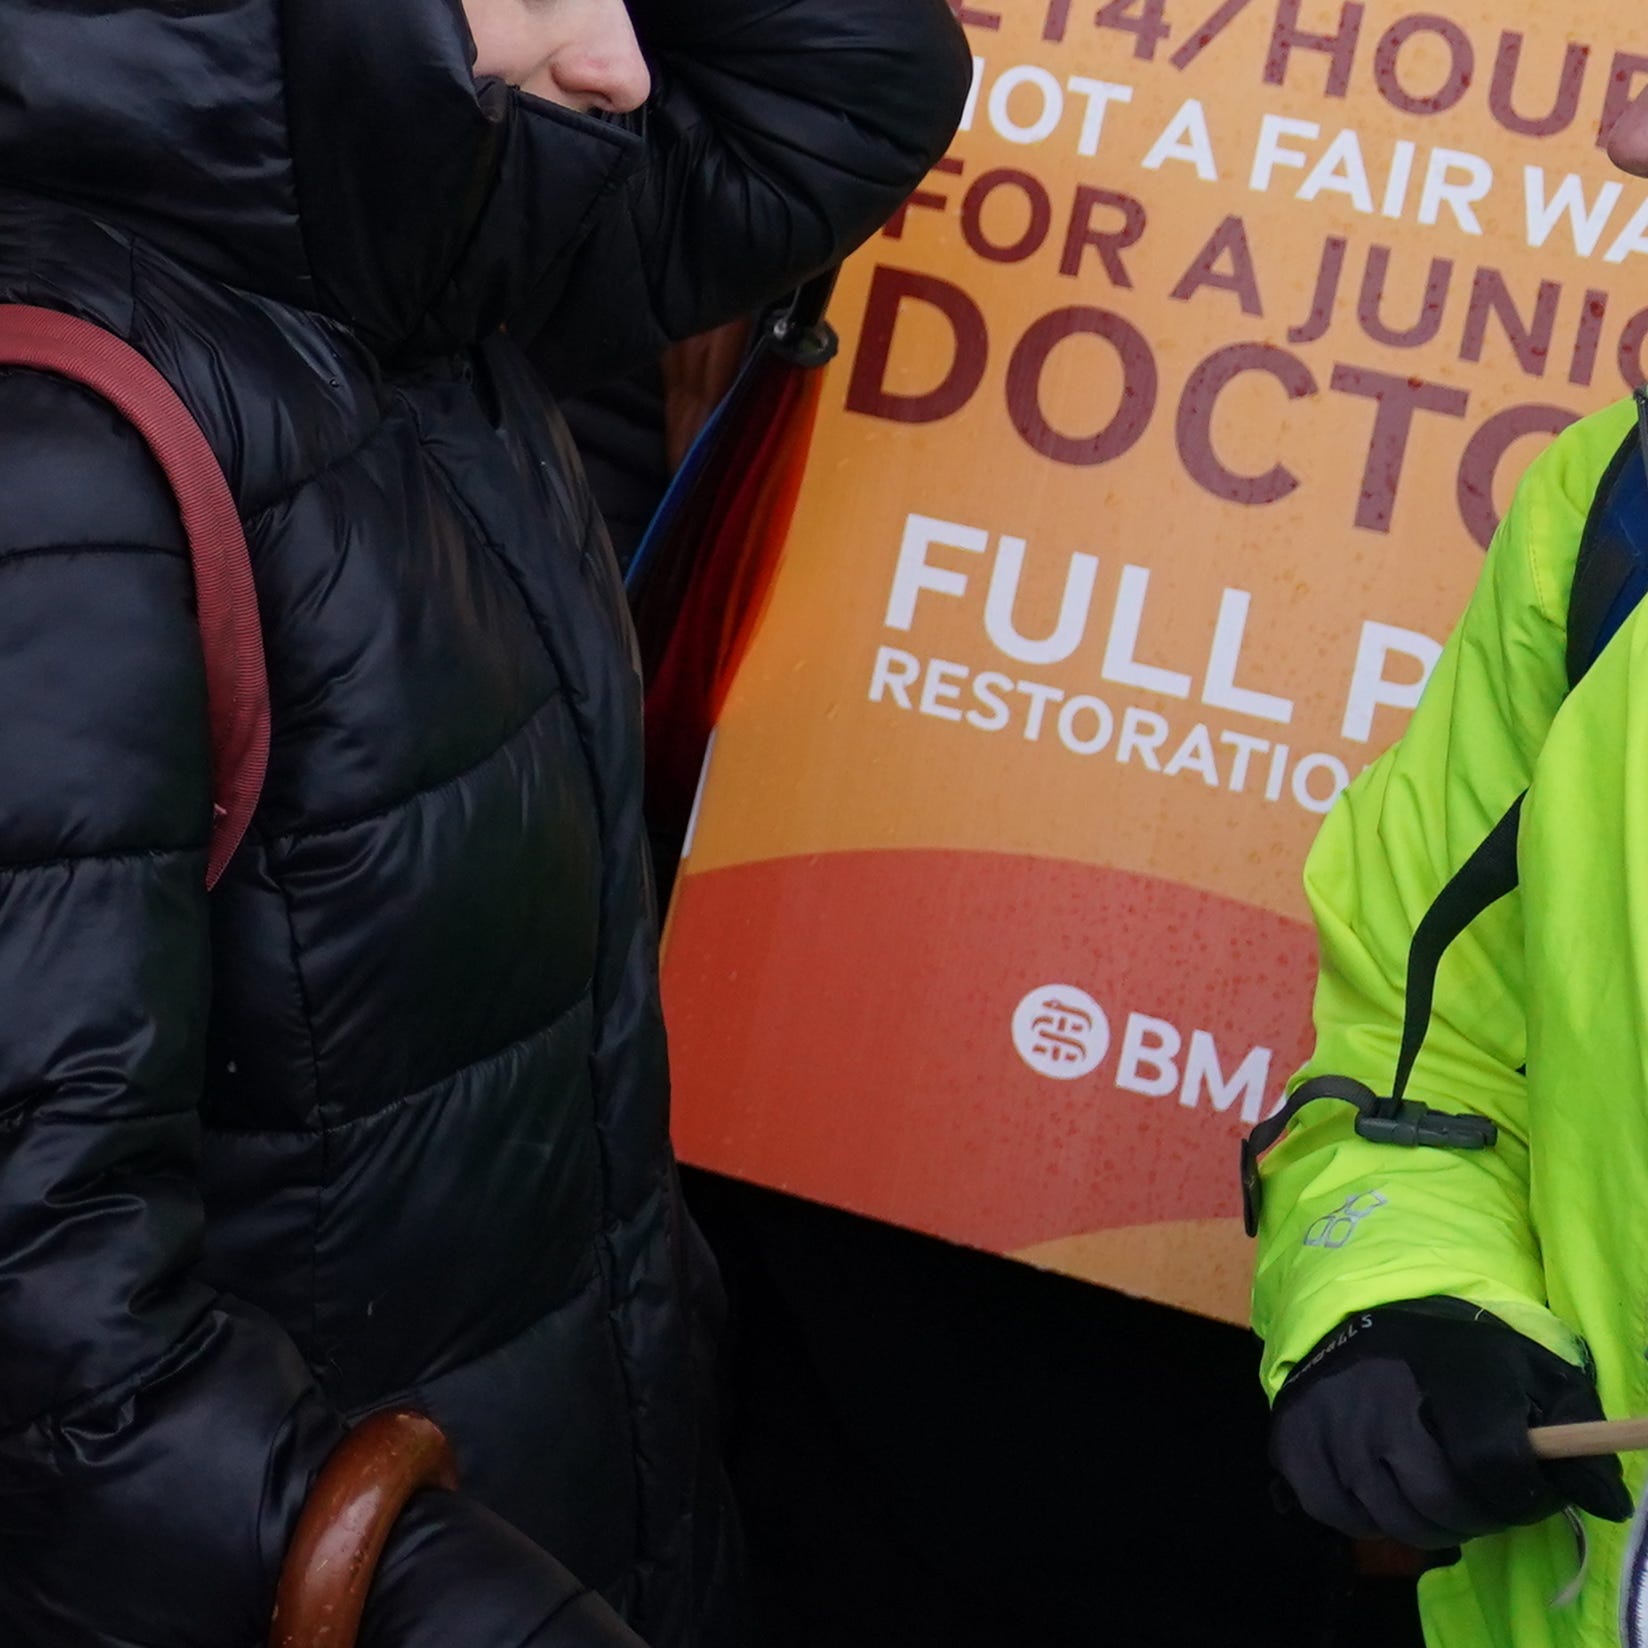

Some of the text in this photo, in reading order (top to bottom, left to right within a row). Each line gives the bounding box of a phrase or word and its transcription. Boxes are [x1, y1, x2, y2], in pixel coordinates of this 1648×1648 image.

[959, 56, 1132, 157] OT
[1142, 98, 1218, 182] A
[1248, 122, 1494, 236] FAIR
[882, 155, 1147, 289] FOR
[1170, 214, 1264, 318] A
[884, 512, 1293, 724] FULL
[868, 645, 1369, 814] RESTORATIO
[1115, 1011, 1289, 1127] BM
